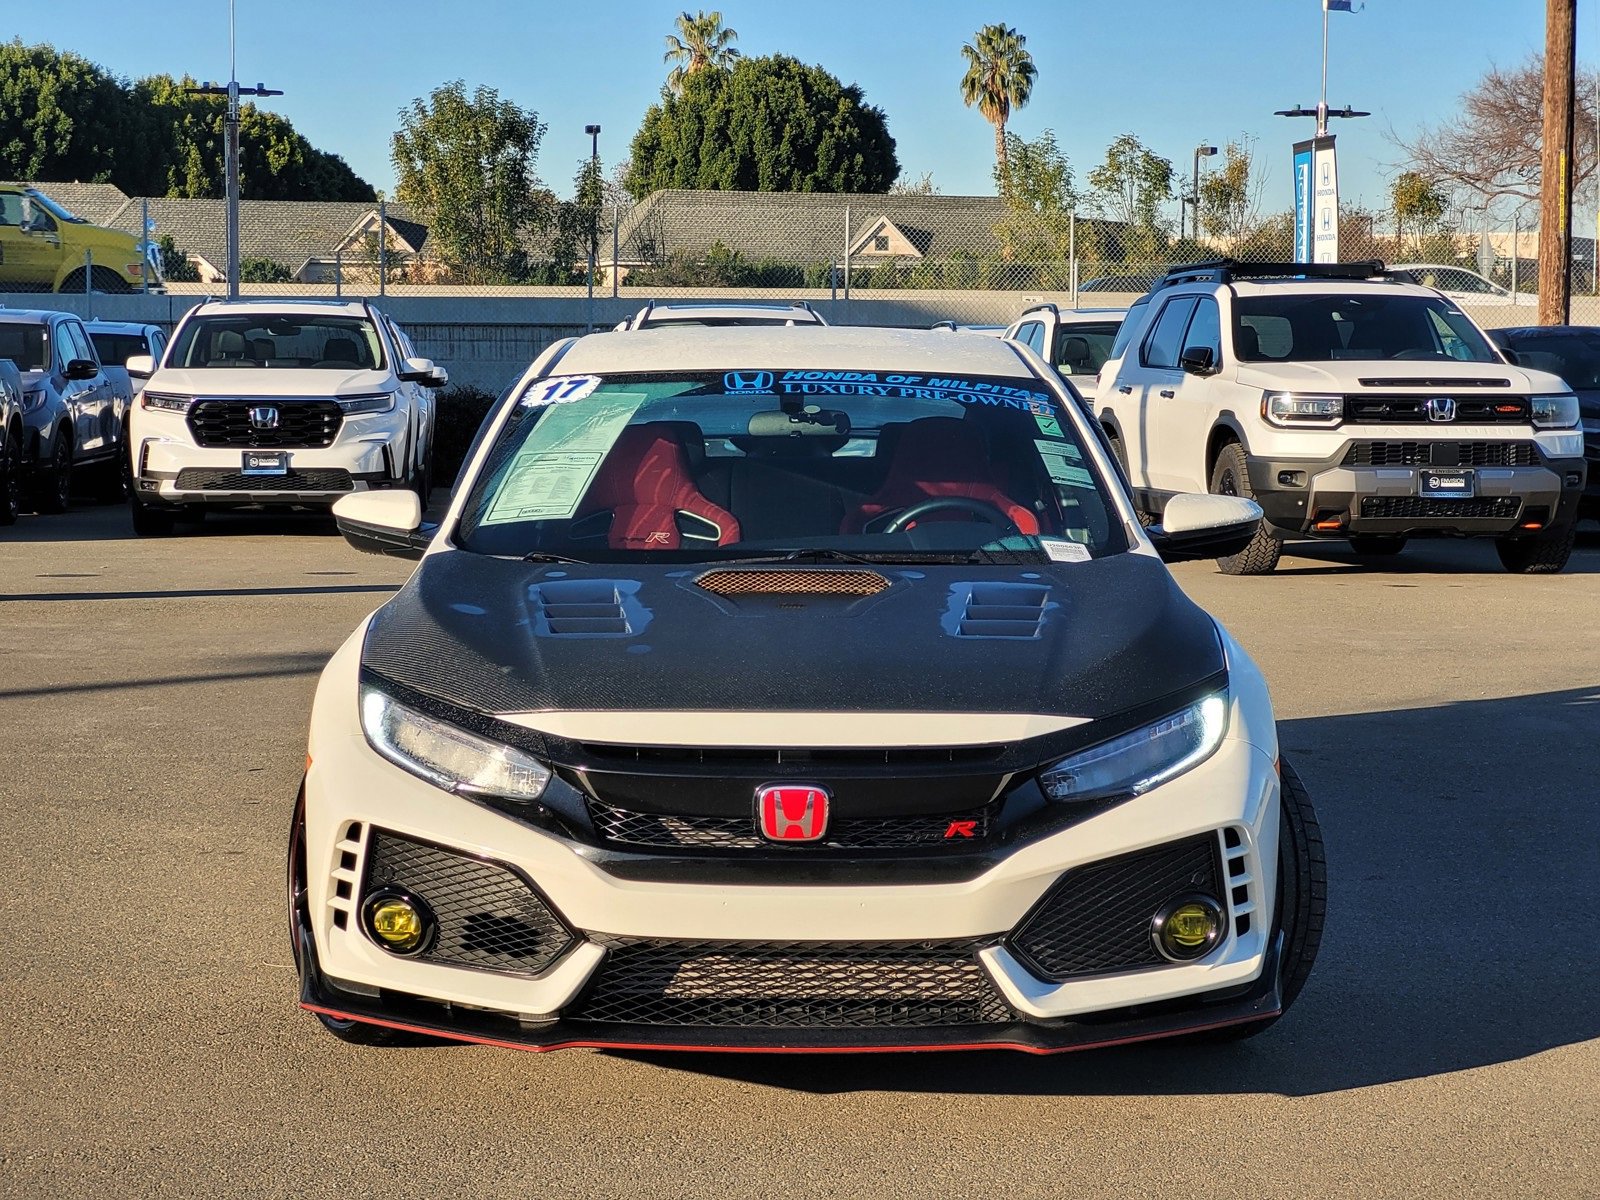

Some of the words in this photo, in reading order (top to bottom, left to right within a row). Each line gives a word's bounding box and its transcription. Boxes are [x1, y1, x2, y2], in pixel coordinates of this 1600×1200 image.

[1317, 188, 1335, 197] HONDA
[1316, 233, 1336, 242] HONDA
[541, 379, 590, 401] 17
[783, 371, 877, 382] HONDA
[886, 375, 922, 385] OF
[927, 378, 1049, 402] MILPITAS
[783, 384, 892, 396] LUXURY
[899, 388, 1056, 415] PRE-OWNED
[645, 532, 670, 544] R
[943, 820, 978, 839] R
